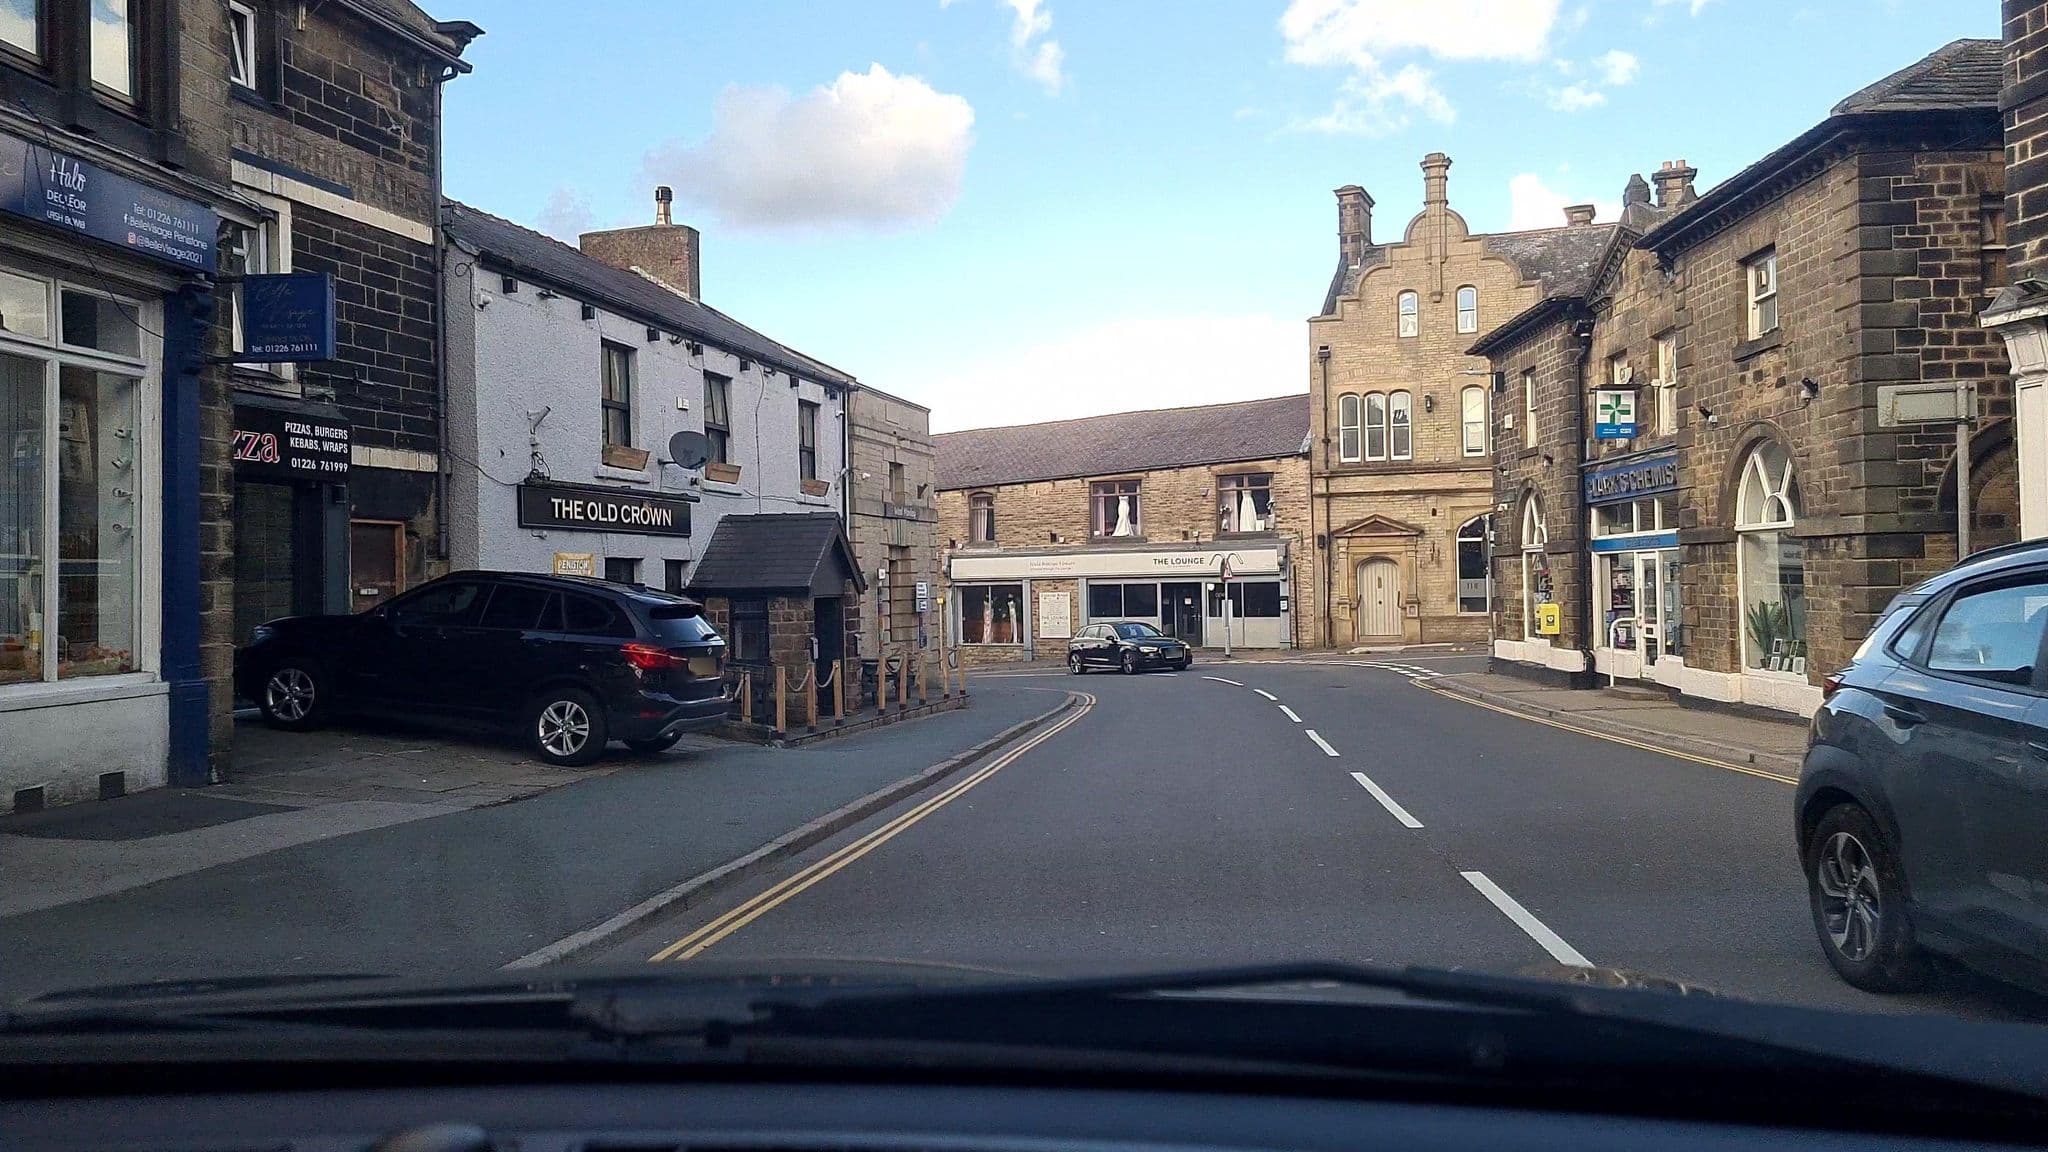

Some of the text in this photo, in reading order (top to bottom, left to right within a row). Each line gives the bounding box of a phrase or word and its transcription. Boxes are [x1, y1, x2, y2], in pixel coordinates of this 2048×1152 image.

[50, 156, 86, 192] Halo
[147, 208, 171, 225] 01226
[173, 217, 199, 234] 761111
[264, 344, 289, 353] 01226
[290, 343, 318, 352] 761111
[284, 421, 348, 440] PIZZAS, BURGERS
[289, 436, 348, 454] KEBABS, WRAPS
[291, 458, 348, 473] 01226 761999
[551, 497, 672, 527] THE OLD CROWN
[1170, 557, 1205, 565] LOUNGE
